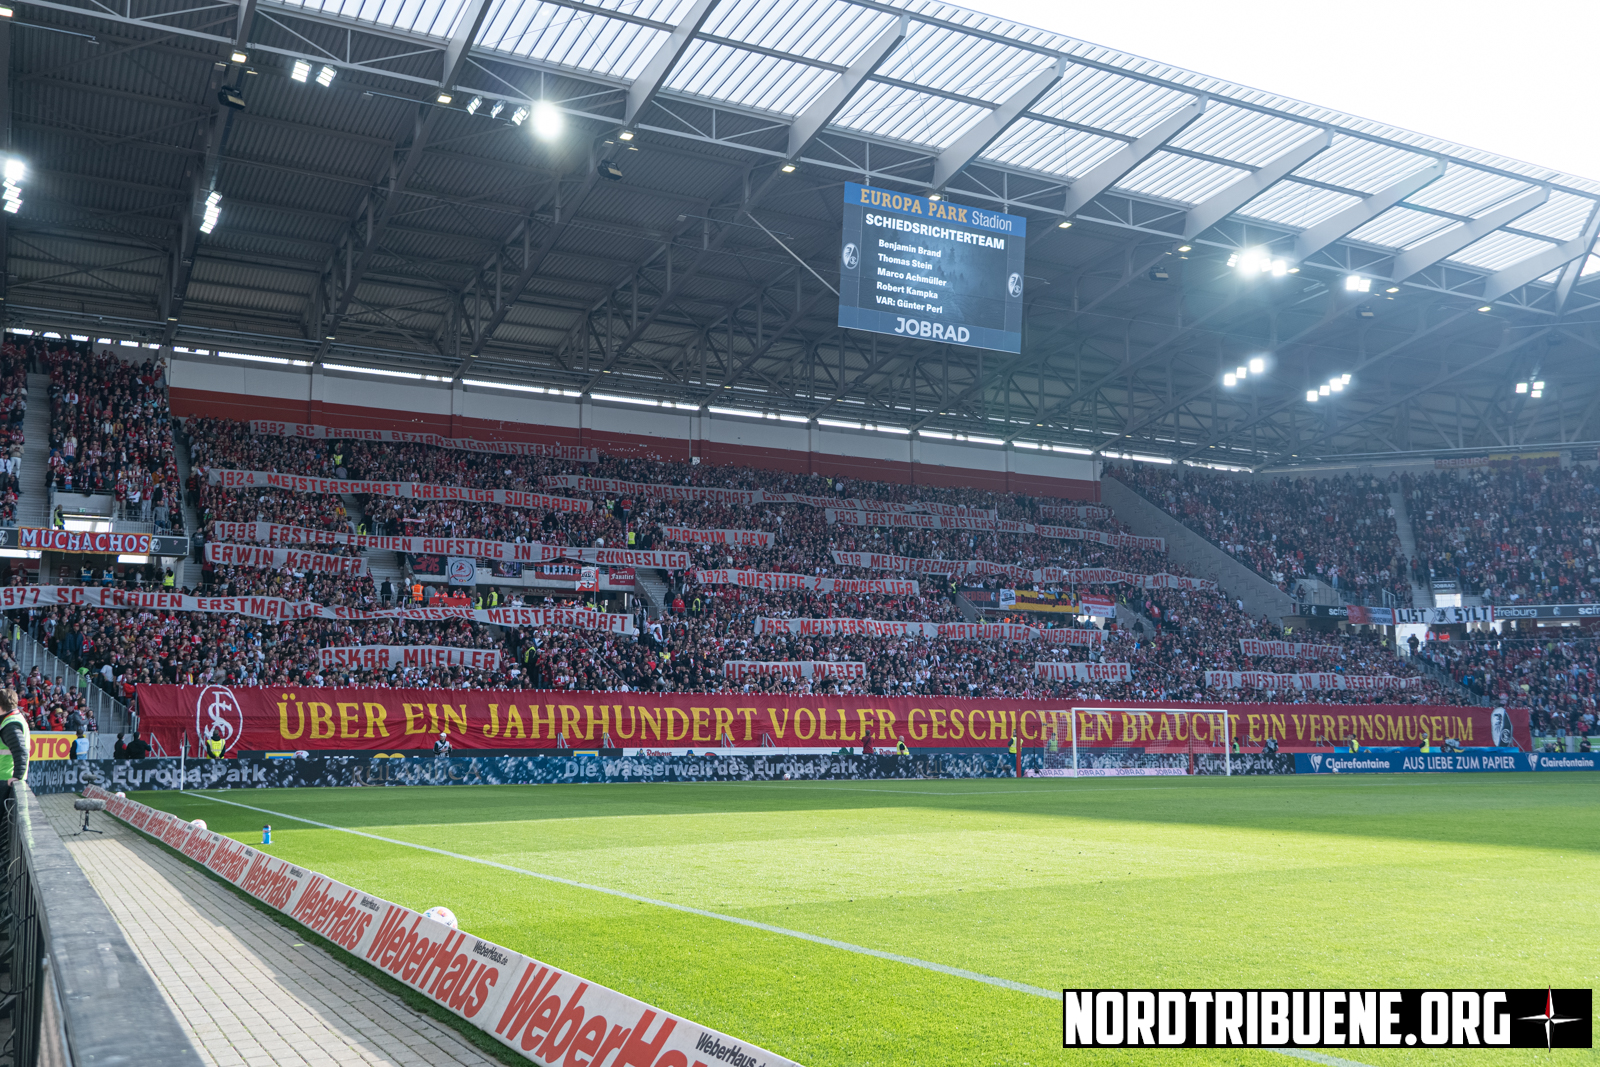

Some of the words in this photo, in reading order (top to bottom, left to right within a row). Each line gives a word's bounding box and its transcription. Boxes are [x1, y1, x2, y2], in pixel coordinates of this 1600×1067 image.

[860, 188, 922, 214] EUROPA
[928, 202, 968, 222] PARK
[972, 210, 1012, 232] Stadion
[866, 214, 1004, 250] SCHIEDSRICHTERTEAM
[878, 239, 916, 254] Benjamin
[918, 246, 942, 258] Brand
[878, 253, 910, 266] Thomas
[912, 260, 932, 270] Stein
[877, 267, 904, 279] Marco
[906, 272, 947, 286] Achmüller
[876, 282, 904, 294] Robert
[906, 287, 938, 299] Kampka
[876, 296, 896, 306] VAR:
[897, 300, 925, 312] Günter
[926, 304, 942, 313] Perl
[894, 317, 970, 342] JOBRAD
[254, 422, 285, 436] 1992
[296, 425, 314, 437] SC
[325, 428, 382, 440] FRAUEN
[392, 431, 592, 460] BEZIRKSLIGAMEISTERSCHAFT
[544, 475, 568, 487] 1917
[219, 471, 255, 486] 1924
[268, 474, 401, 496] MEISTERSCHAFT
[412, 484, 494, 501] KREISLIGA
[505, 491, 588, 514] SUEDBADEN
[834, 511, 858, 524] 1935
[866, 512, 934, 527] ERSTMALIGE
[21, 528, 149, 552] MUCHACHOS
[219, 524, 256, 539] 1998
[269, 525, 335, 543] ERSTER
[347, 535, 411, 550] FRAUEN
[424, 539, 503, 558] AUFSTIEG
[514, 545, 531, 559] IN
[542, 547, 567, 559] DIE
[596, 551, 686, 567] BUNDESLIGA
[667, 528, 725, 543] JOACHIM
[734, 532, 768, 546] LOEW
[211, 544, 274, 564] ERWIN
[286, 552, 362, 573] KRAMER
[837, 553, 862, 566] 1918
[871, 554, 968, 573] MEISTERSCHAFT
[701, 570, 728, 583] 1978
[738, 572, 805, 590] AUFSTIEG
[814, 578, 825, 591] 2.
[834, 579, 913, 595] BUNDESLIGA
[0, 588, 40, 606] 977
[57, 588, 84, 605] SC
[100, 588, 182, 608] FRAUEN
[198, 598, 323, 618] ERSTMALIGE
[488, 609, 628, 631] MEISTERSCHAFT
[1398, 609, 1426, 623] LIST
[1454, 607, 1489, 621] SYLT
[800, 620, 907, 636] MEISTERSCHAFT
[919, 624, 928, 637] 1.
[938, 624, 1030, 642] AMATEURLIGA
[1040, 629, 1102, 644] SUEDBADEN
[1243, 641, 1295, 656] REINHOLD
[322, 649, 389, 669] OSKAR
[404, 649, 495, 669] MUELLER
[725, 664, 801, 680] HERMANN
[813, 664, 864, 680] WEBER
[1039, 664, 1076, 680] WILLI
[1210, 673, 1233, 687] 1941
[1241, 673, 1294, 688] AUFSTIEG
[1299, 676, 1312, 688] IN
[1320, 675, 1338, 688] DIE
[277, 693, 390, 740] ÜBER
[402, 703, 468, 735] EIN
[482, 703, 757, 741] JAHRHUNDERT
[768, 708, 896, 740] VOLLER
[908, 709, 1113, 741] GESCHICHTEN
[1123, 713, 1240, 742] BRAUCHT
[1248, 714, 1286, 741] EIN
[1291, 714, 1474, 741] VEREINSMUSEUM
[565, 761, 597, 777] Die
[603, 760, 712, 776] Wasserwelt
[718, 760, 749, 775] des
[754, 759, 858, 778] Europa-Park
[1326, 757, 1390, 769] Clairefontaine
[1403, 756, 1425, 770] AUS
[1428, 756, 1453, 769] LIEBE
[1456, 756, 1480, 769] ZUM
[1483, 756, 1515, 769] PAPIER
[1540, 757, 1594, 767] Clairefontaine
[240, 853, 298, 910] WeberHaus
[290, 875, 373, 950] WeberHaus
[366, 906, 499, 1018] WeberHaus
[472, 940, 508, 966] WeberHaus.de
